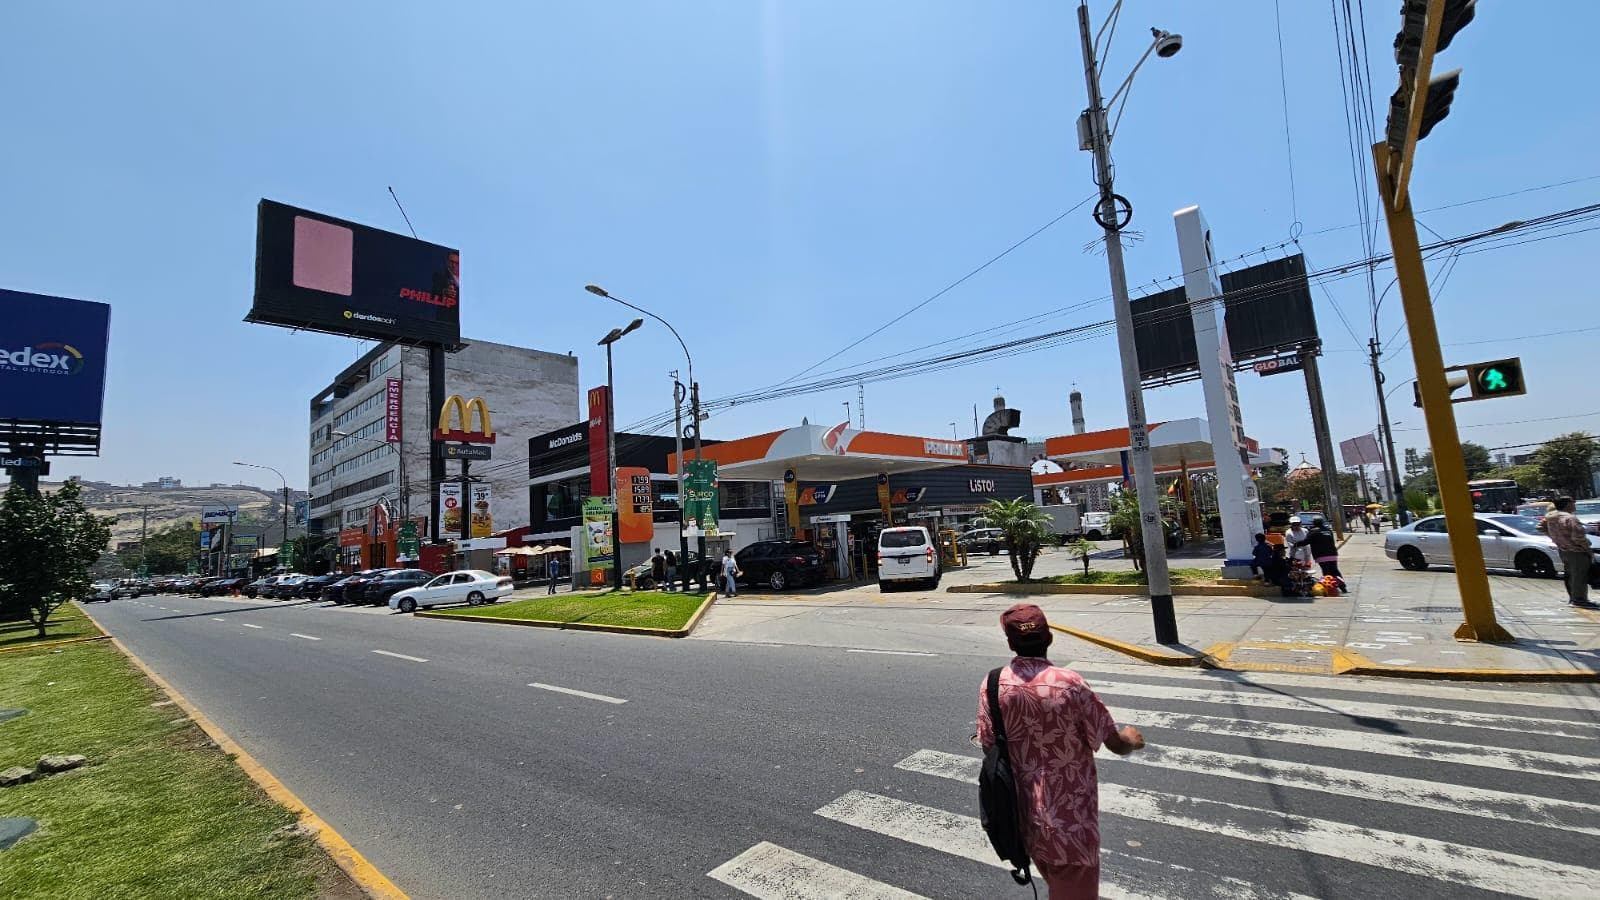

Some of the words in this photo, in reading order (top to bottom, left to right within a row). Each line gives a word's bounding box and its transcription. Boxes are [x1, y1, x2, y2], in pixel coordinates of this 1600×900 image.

[400, 287, 457, 308] PHILLIP
[1254, 357, 1300, 371] GLOBAL
[389, 381, 399, 441] EMERGENCIA
